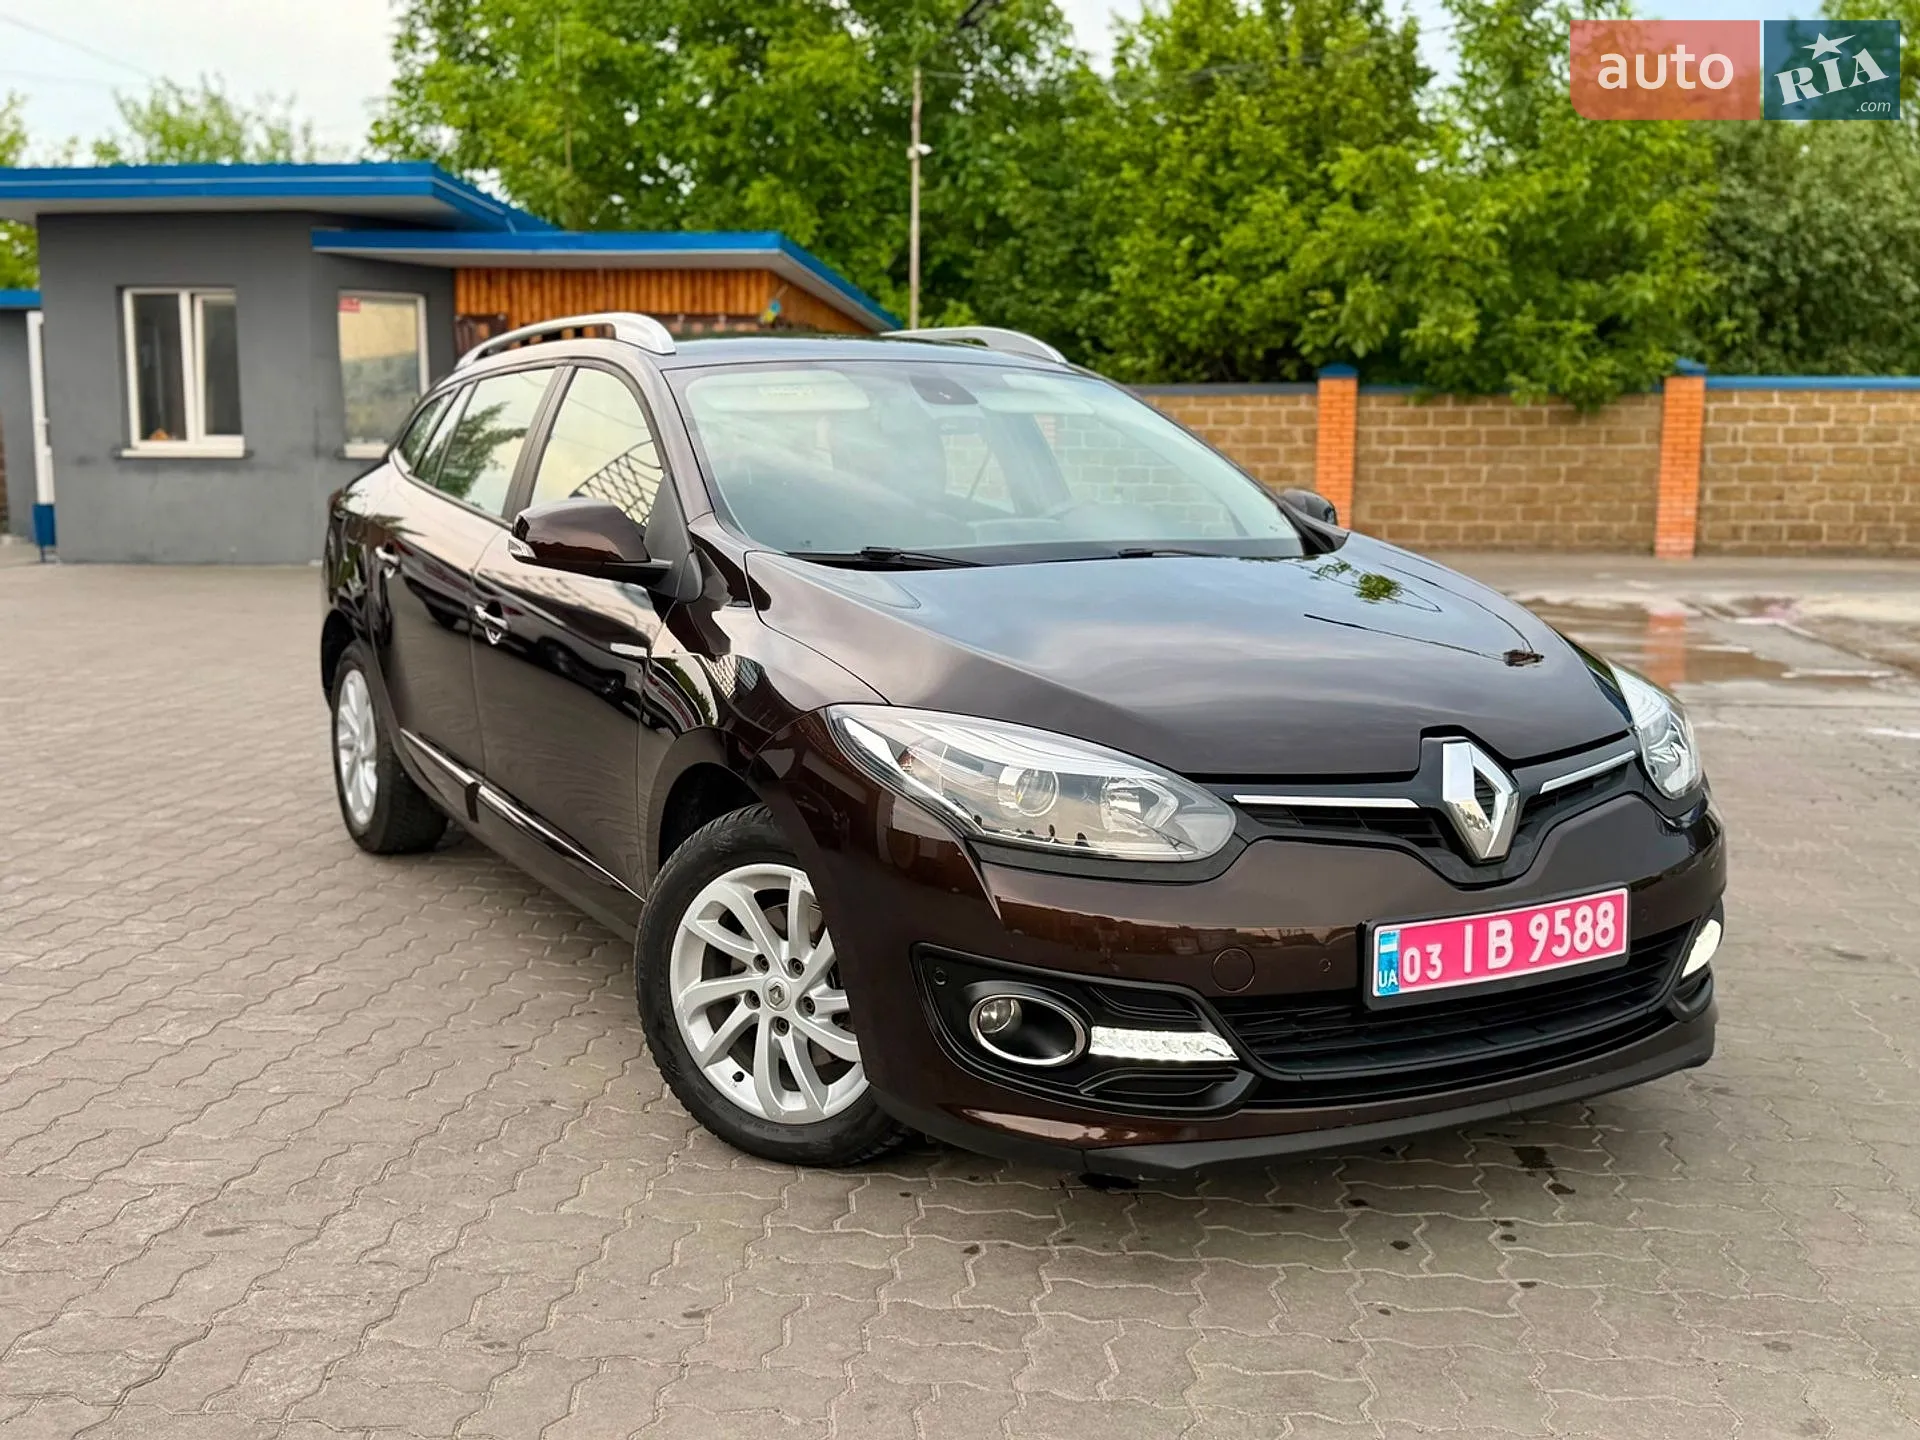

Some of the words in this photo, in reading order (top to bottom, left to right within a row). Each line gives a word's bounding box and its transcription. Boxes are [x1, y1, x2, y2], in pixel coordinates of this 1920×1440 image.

[1402, 943, 1443, 983] 03
[1463, 919, 1514, 974] IB
[1527, 900, 1616, 963] 9588
[1378, 969, 1399, 988] UA
